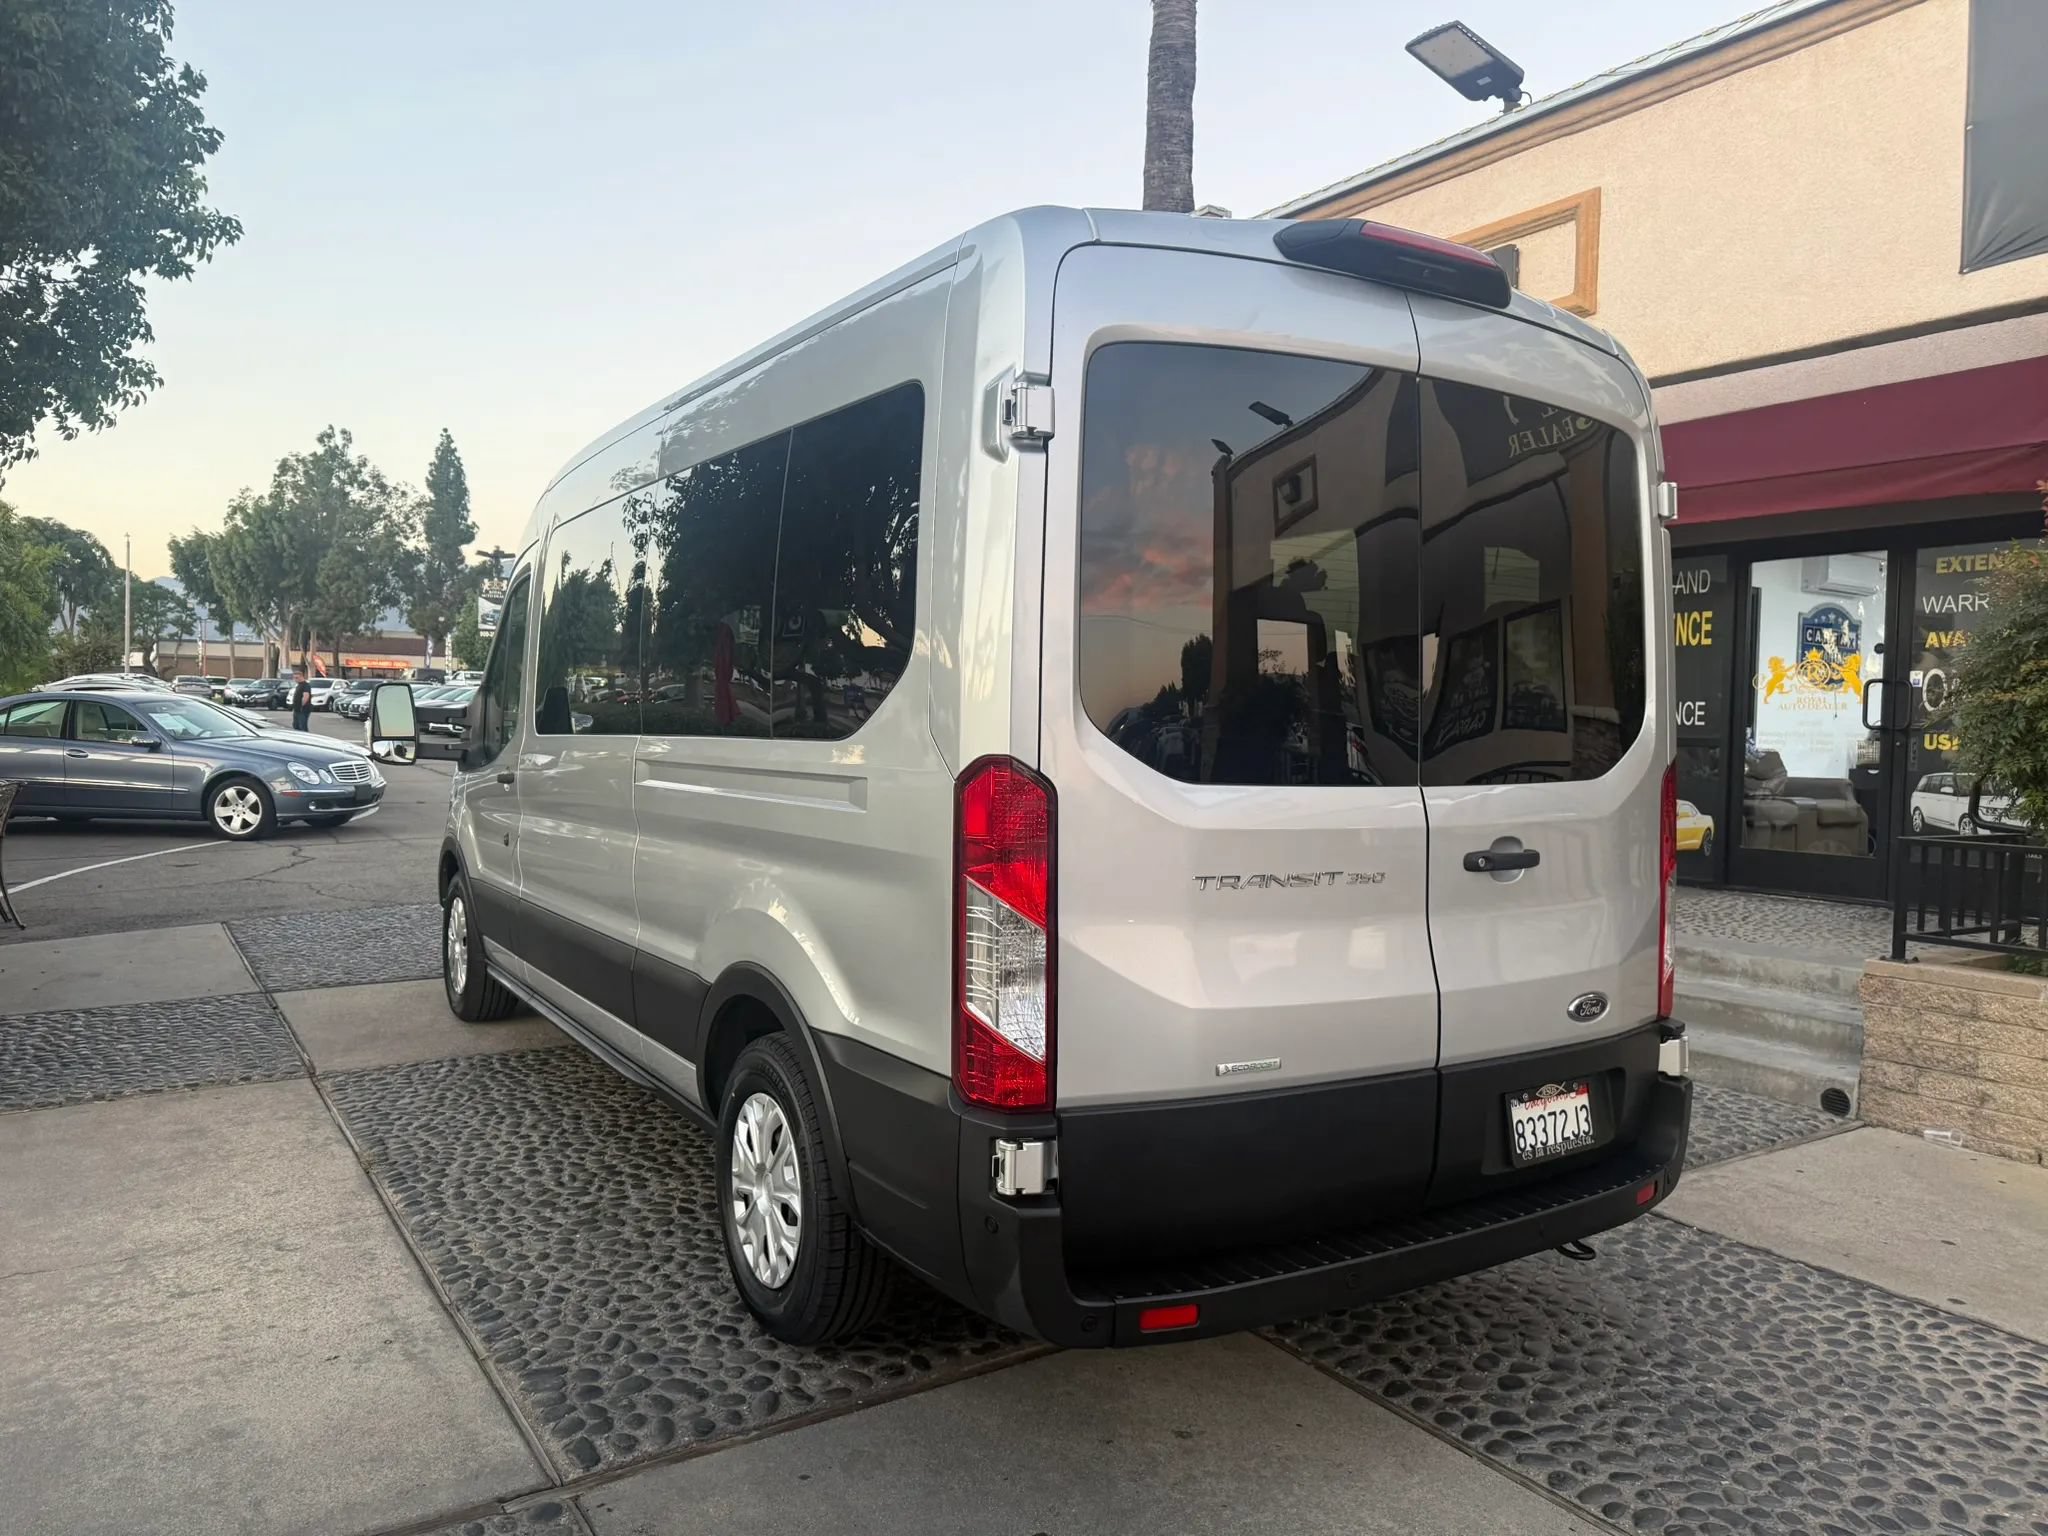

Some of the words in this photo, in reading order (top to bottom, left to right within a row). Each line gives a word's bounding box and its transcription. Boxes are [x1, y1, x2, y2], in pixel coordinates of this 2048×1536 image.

[1935, 553, 2014, 574] EXTEN
[1675, 569, 1711, 595] AND
[1922, 593, 1990, 614] WARR
[1674, 610, 1713, 646] NCE
[1925, 630, 1969, 649] AVA
[1779, 703, 1805, 711] AUTO
[1797, 695, 1828, 705] ROYAL
[1192, 871, 1344, 891] TRANSIT
[1346, 872, 1386, 885] 350
[1580, 999, 1602, 1016] Ford
[1232, 1061, 1278, 1073] ECOBOOST
[1515, 1103, 1593, 1152] 83372J3
[1522, 1149, 1533, 1161] es
[1535, 1146, 1545, 1158] la
[1546, 1134, 1595, 1155] respuesta.
